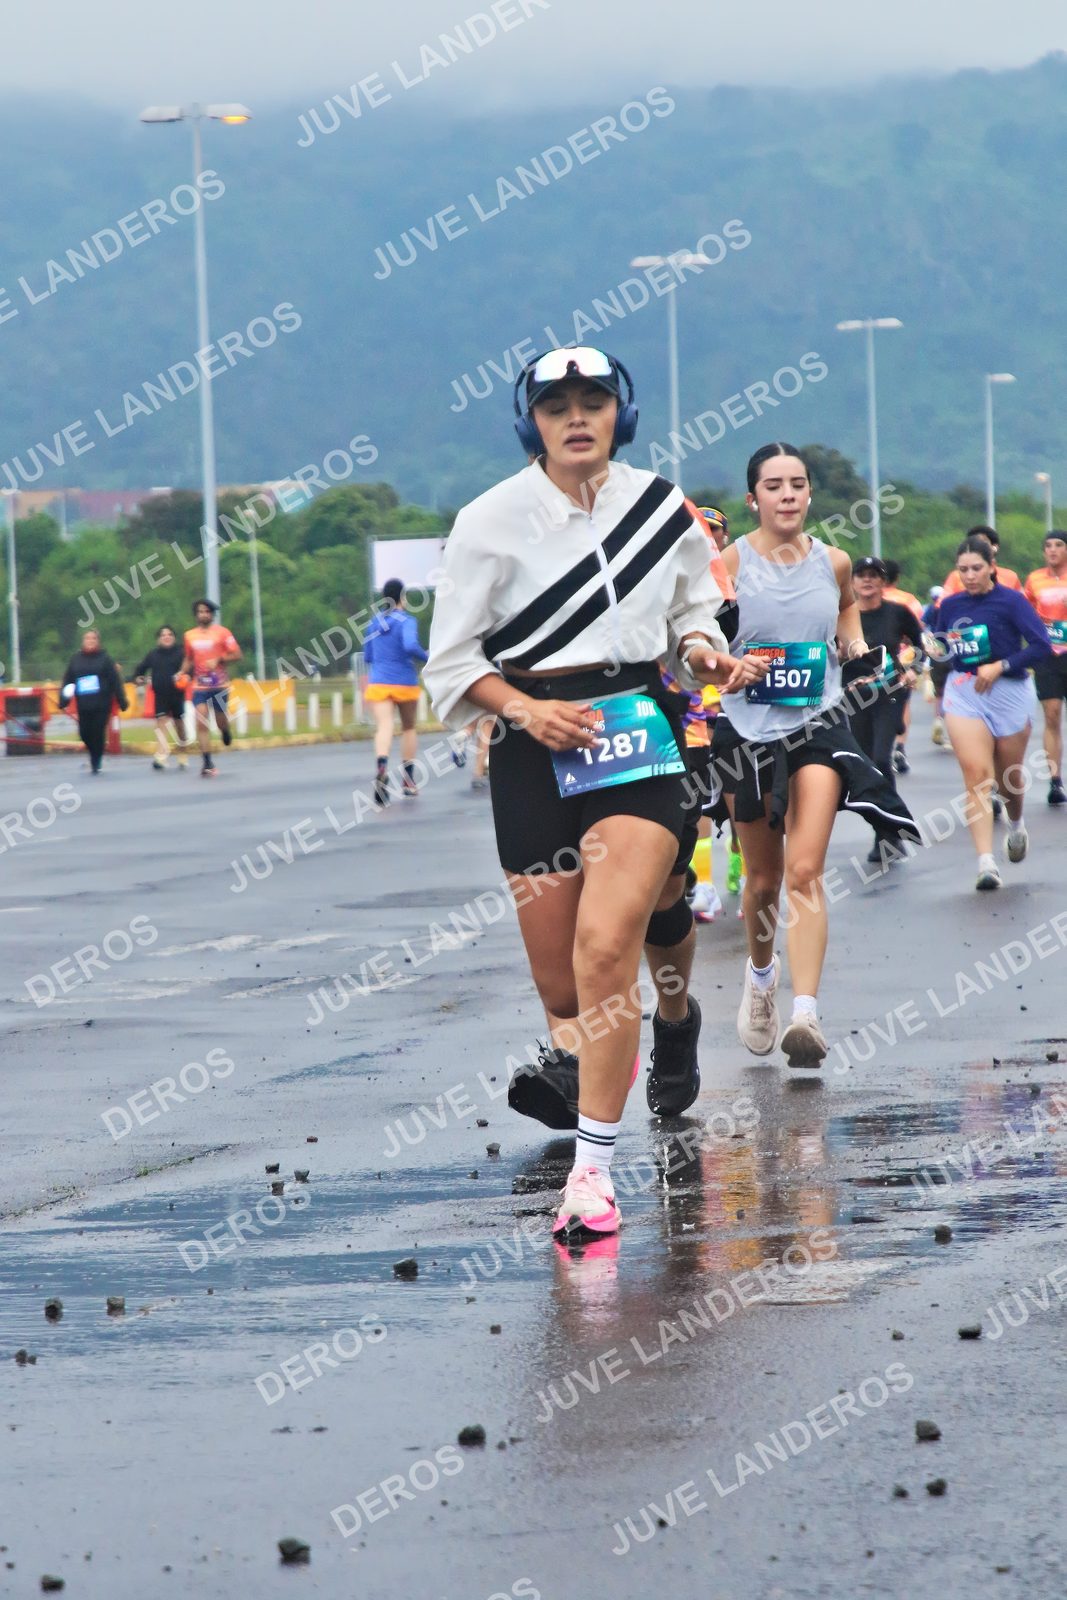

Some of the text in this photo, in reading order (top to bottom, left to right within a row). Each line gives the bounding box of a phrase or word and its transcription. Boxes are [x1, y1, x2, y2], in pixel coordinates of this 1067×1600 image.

[808, 647, 821, 660] 10K
[765, 669, 812, 688] 1507
[577, 729, 648, 765] 1287
